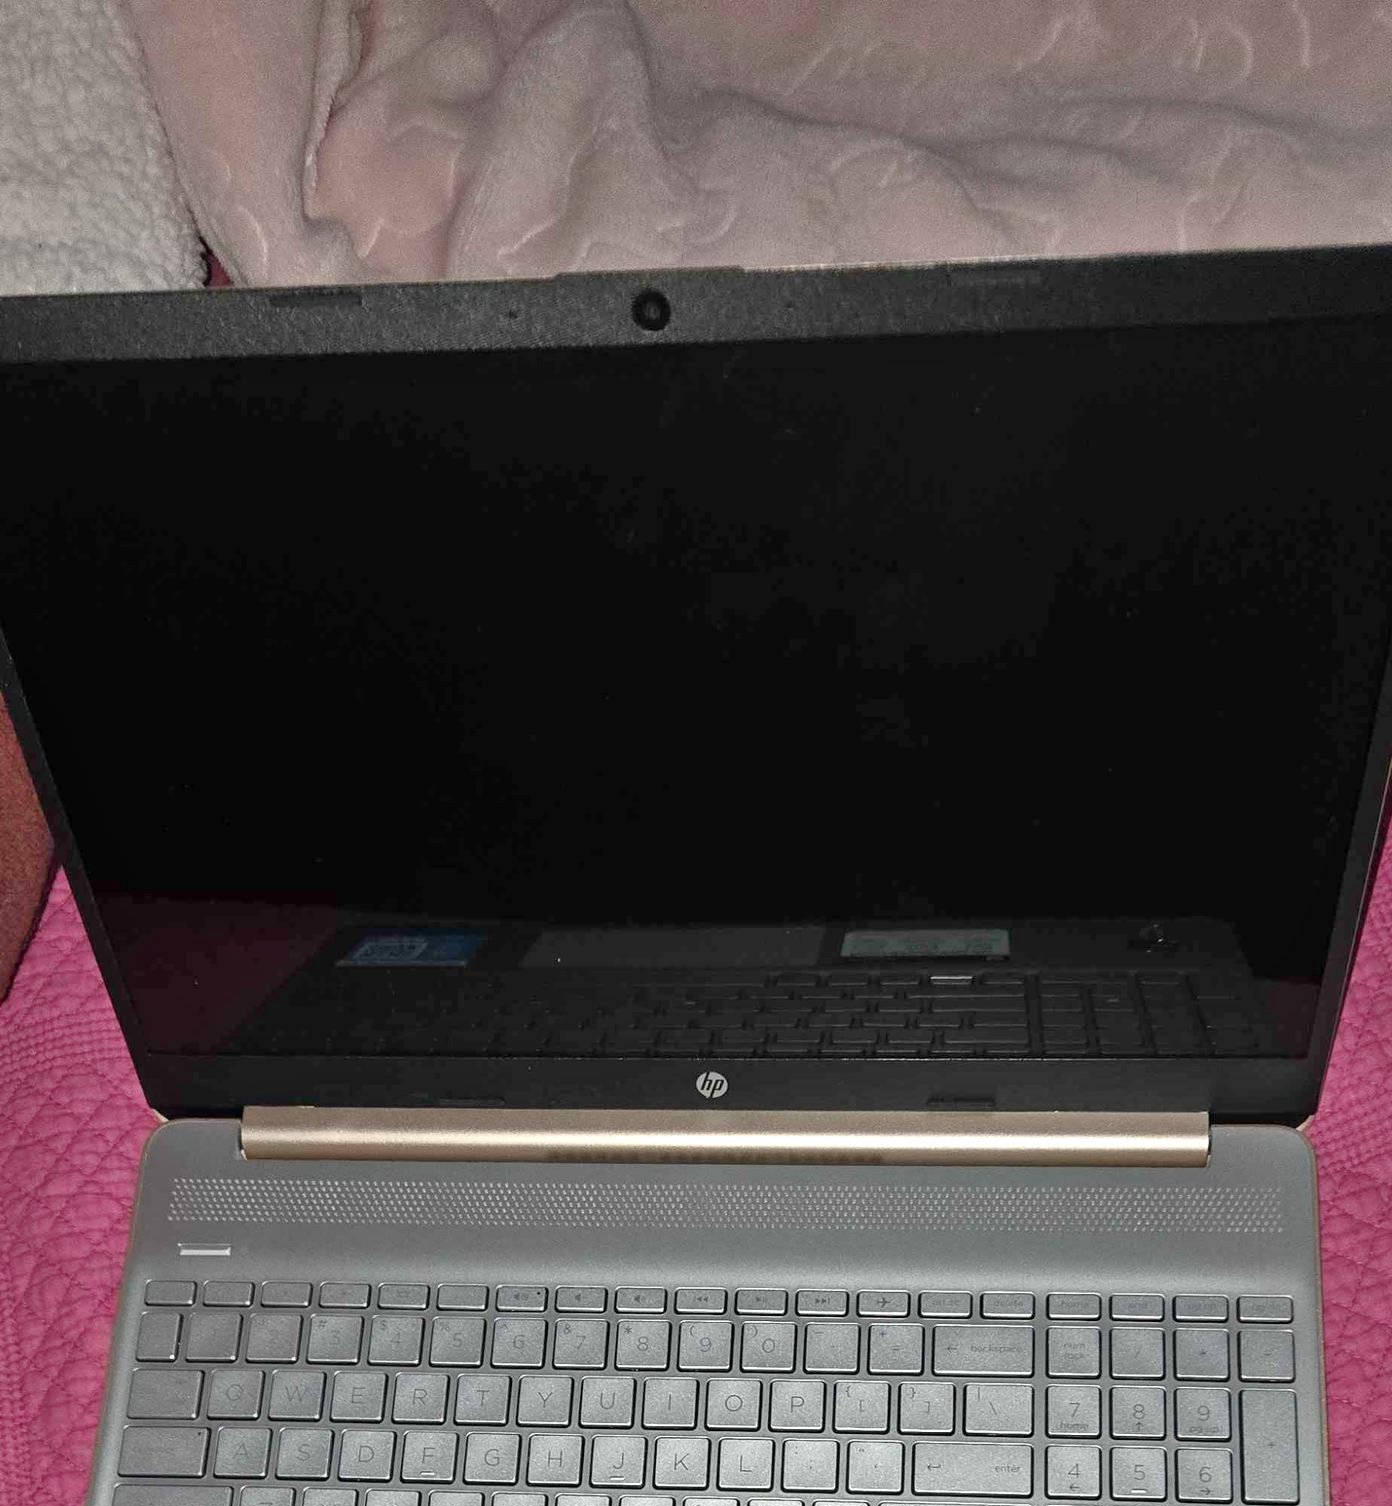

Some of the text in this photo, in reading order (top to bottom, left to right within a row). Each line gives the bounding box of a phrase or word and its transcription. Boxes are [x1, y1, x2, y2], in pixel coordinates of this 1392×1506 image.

[513, 1335, 525, 1349] 6
[575, 1335, 586, 1349] 7
[636, 1336, 649, 1351] 8
[699, 1337, 712, 1352] 9
[285, 1385, 307, 1402] W
[351, 1387, 366, 1404] E
[413, 1389, 428, 1405] R
[477, 1390, 490, 1406] T
[538, 1392, 553, 1407] Y
[600, 1393, 615, 1409] U
[725, 1395, 743, 1412] O
[791, 1396, 805, 1413] P
[1068, 1402, 1081, 1418] 7
[1133, 1403, 1146, 1419] 8
[1197, 1406, 1210, 1421] 9
[234, 1445, 249, 1460] A
[297, 1445, 310, 1461] S
[358, 1446, 374, 1463] D
[423, 1448, 436, 1464] F
[485, 1449, 499, 1466] G
[547, 1450, 562, 1467] H
[612, 1452, 624, 1470] J
[674, 1453, 689, 1471] K
[740, 1455, 752, 1472] L
[995, 1464, 1020, 1473] enter
[1067, 1464, 1081, 1479] 4
[1134, 1465, 1146, 1480] 5
[1199, 1467, 1212, 1482] 6
